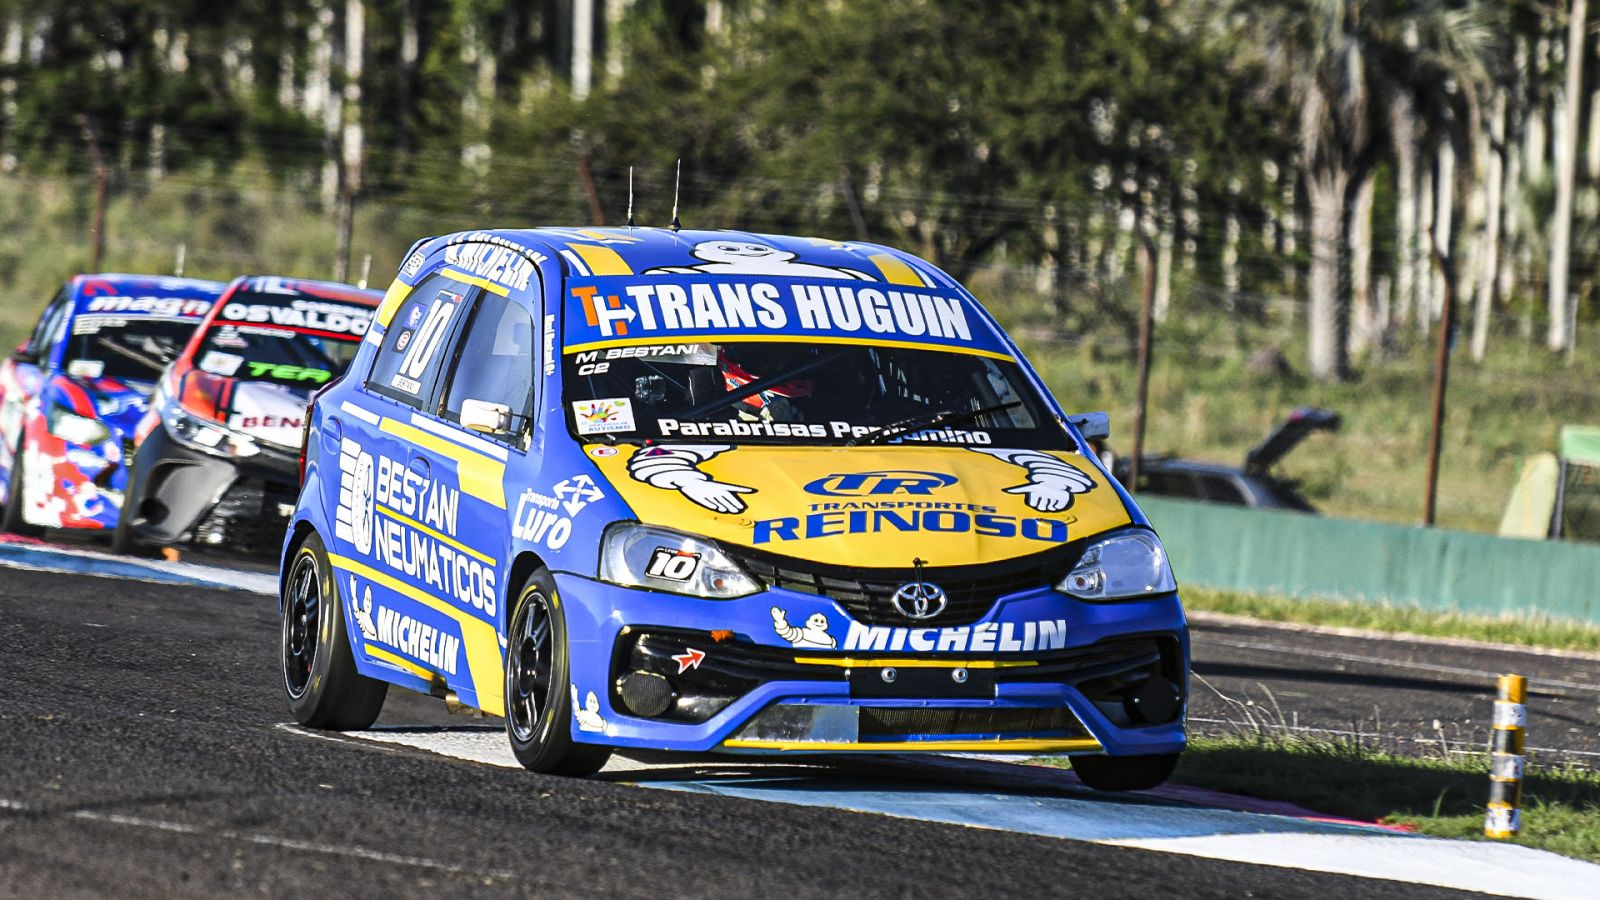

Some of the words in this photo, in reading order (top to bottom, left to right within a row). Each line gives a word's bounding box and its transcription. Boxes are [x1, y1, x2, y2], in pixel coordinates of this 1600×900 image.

[222, 302, 371, 336] OSVALDO
[626, 283, 789, 330] TRANS
[791, 284, 973, 341] HUGUIN
[399, 298, 455, 379] 10
[575, 351, 598, 364] M
[605, 344, 700, 360] BESTANI
[578, 362, 610, 376] C2
[657, 418, 827, 437] Parabrisas
[376, 454, 459, 537] BESTANI
[807, 501, 997, 513] TRANSPORTES
[752, 509, 1069, 545] REINOSO
[374, 514, 497, 618] NEUMATICOS
[650, 551, 697, 579] 10
[377, 604, 460, 675] MICHELIN
[843, 618, 1067, 651] MICHELIN
